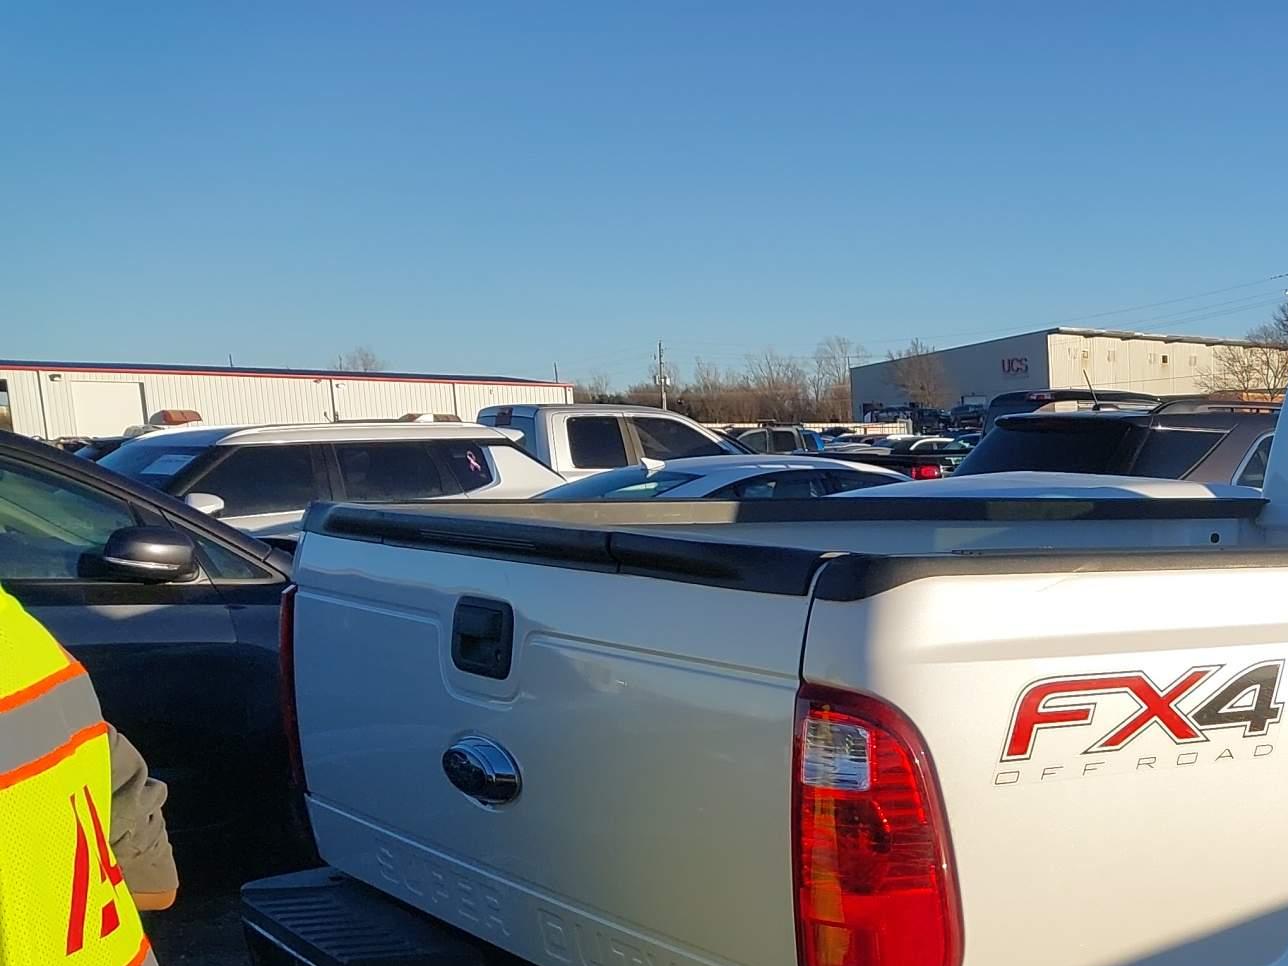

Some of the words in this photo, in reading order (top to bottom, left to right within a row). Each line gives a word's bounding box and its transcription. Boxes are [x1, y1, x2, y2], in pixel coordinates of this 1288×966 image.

[1002, 357, 1029, 374] UCS
[999, 659, 1286, 762] FX4
[994, 761, 1106, 785] OFF
[1136, 744, 1274, 770] ROAD
